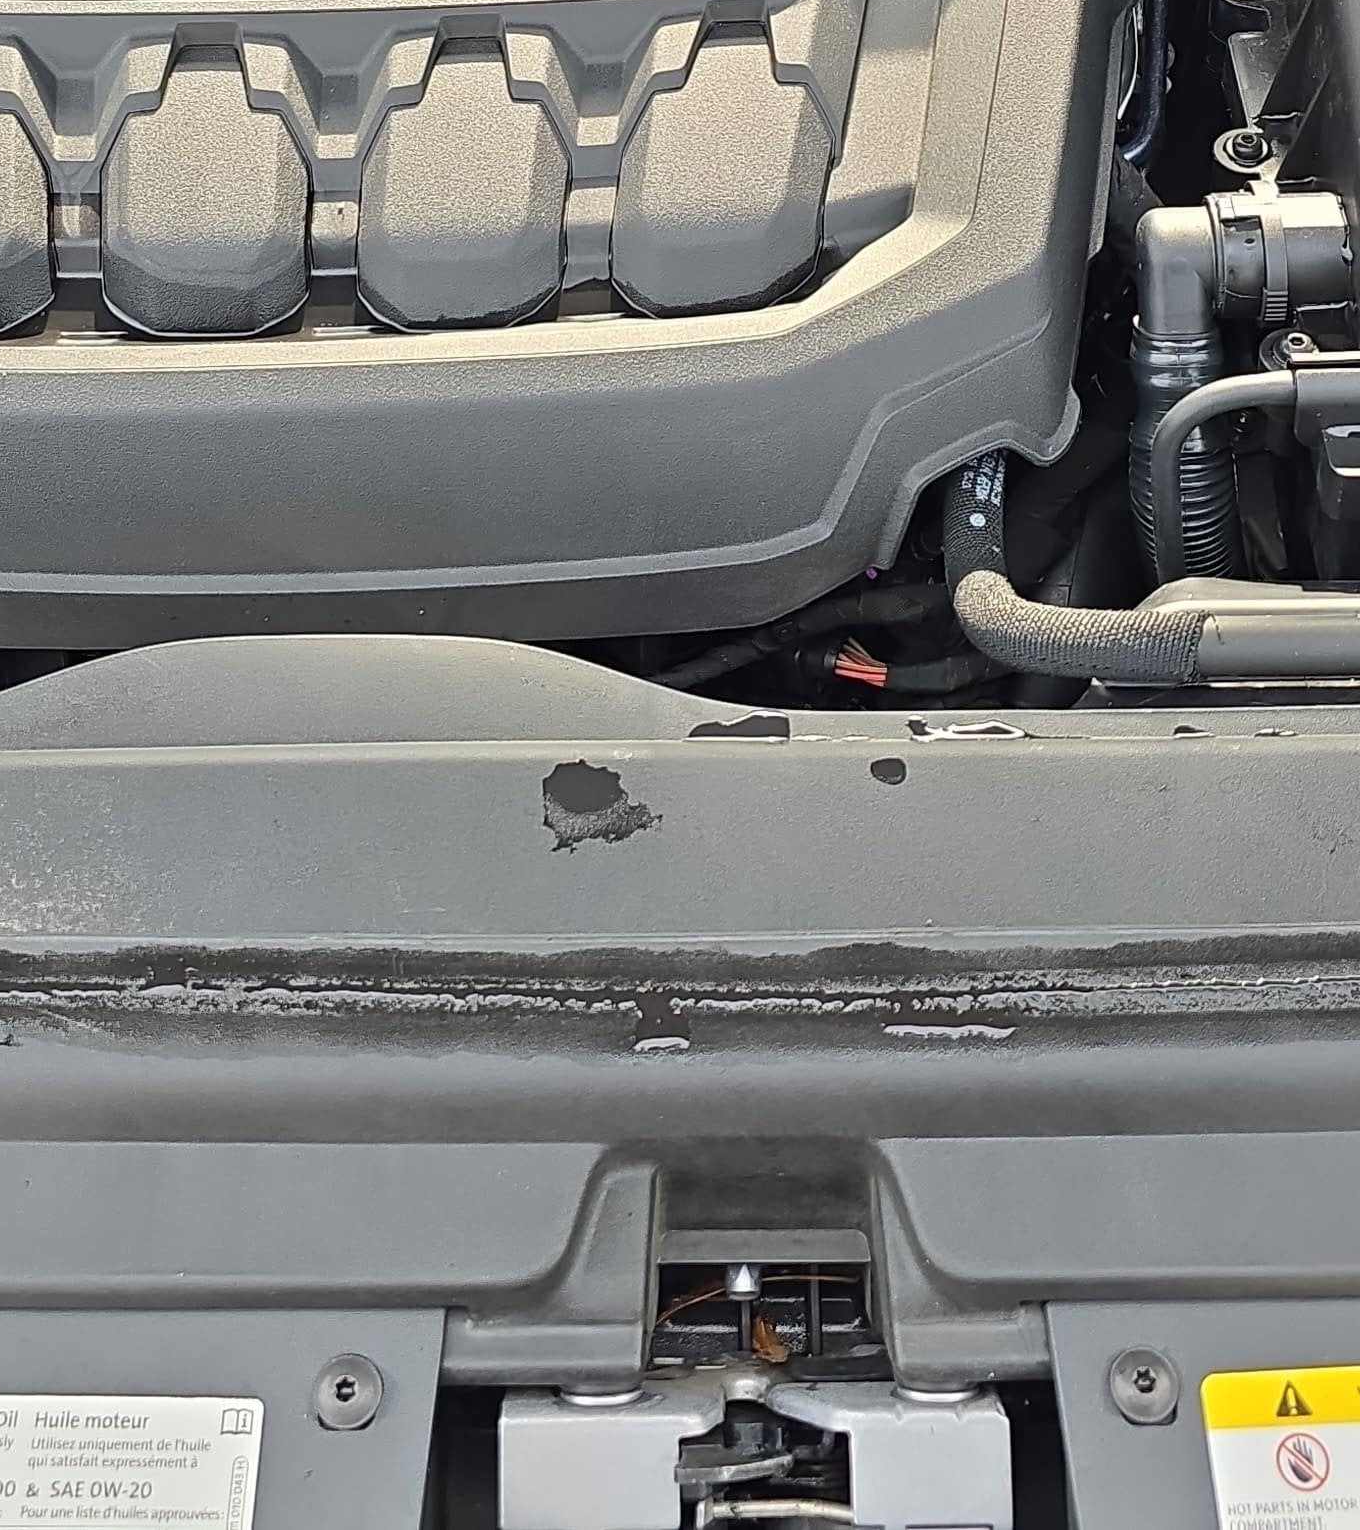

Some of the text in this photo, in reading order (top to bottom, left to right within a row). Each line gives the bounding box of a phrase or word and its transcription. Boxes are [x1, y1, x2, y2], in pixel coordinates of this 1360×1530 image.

[35, 1411, 80, 1428] Huile
[85, 1413, 149, 1429] moteur
[31, 1438, 211, 1452] Utilisez uniquement de l'huile
[28, 1454, 198, 1469] qui satisfait expressément à
[26, 1483, 39, 1497] &
[50, 1480, 85, 1498] SAE
[90, 1481, 152, 1498] 0W-20
[20, 1505, 224, 1522] Pour une liste d'huiles approuvées:
[1227, 1497, 1358, 1515] HOT PARTS IN MOTOR
